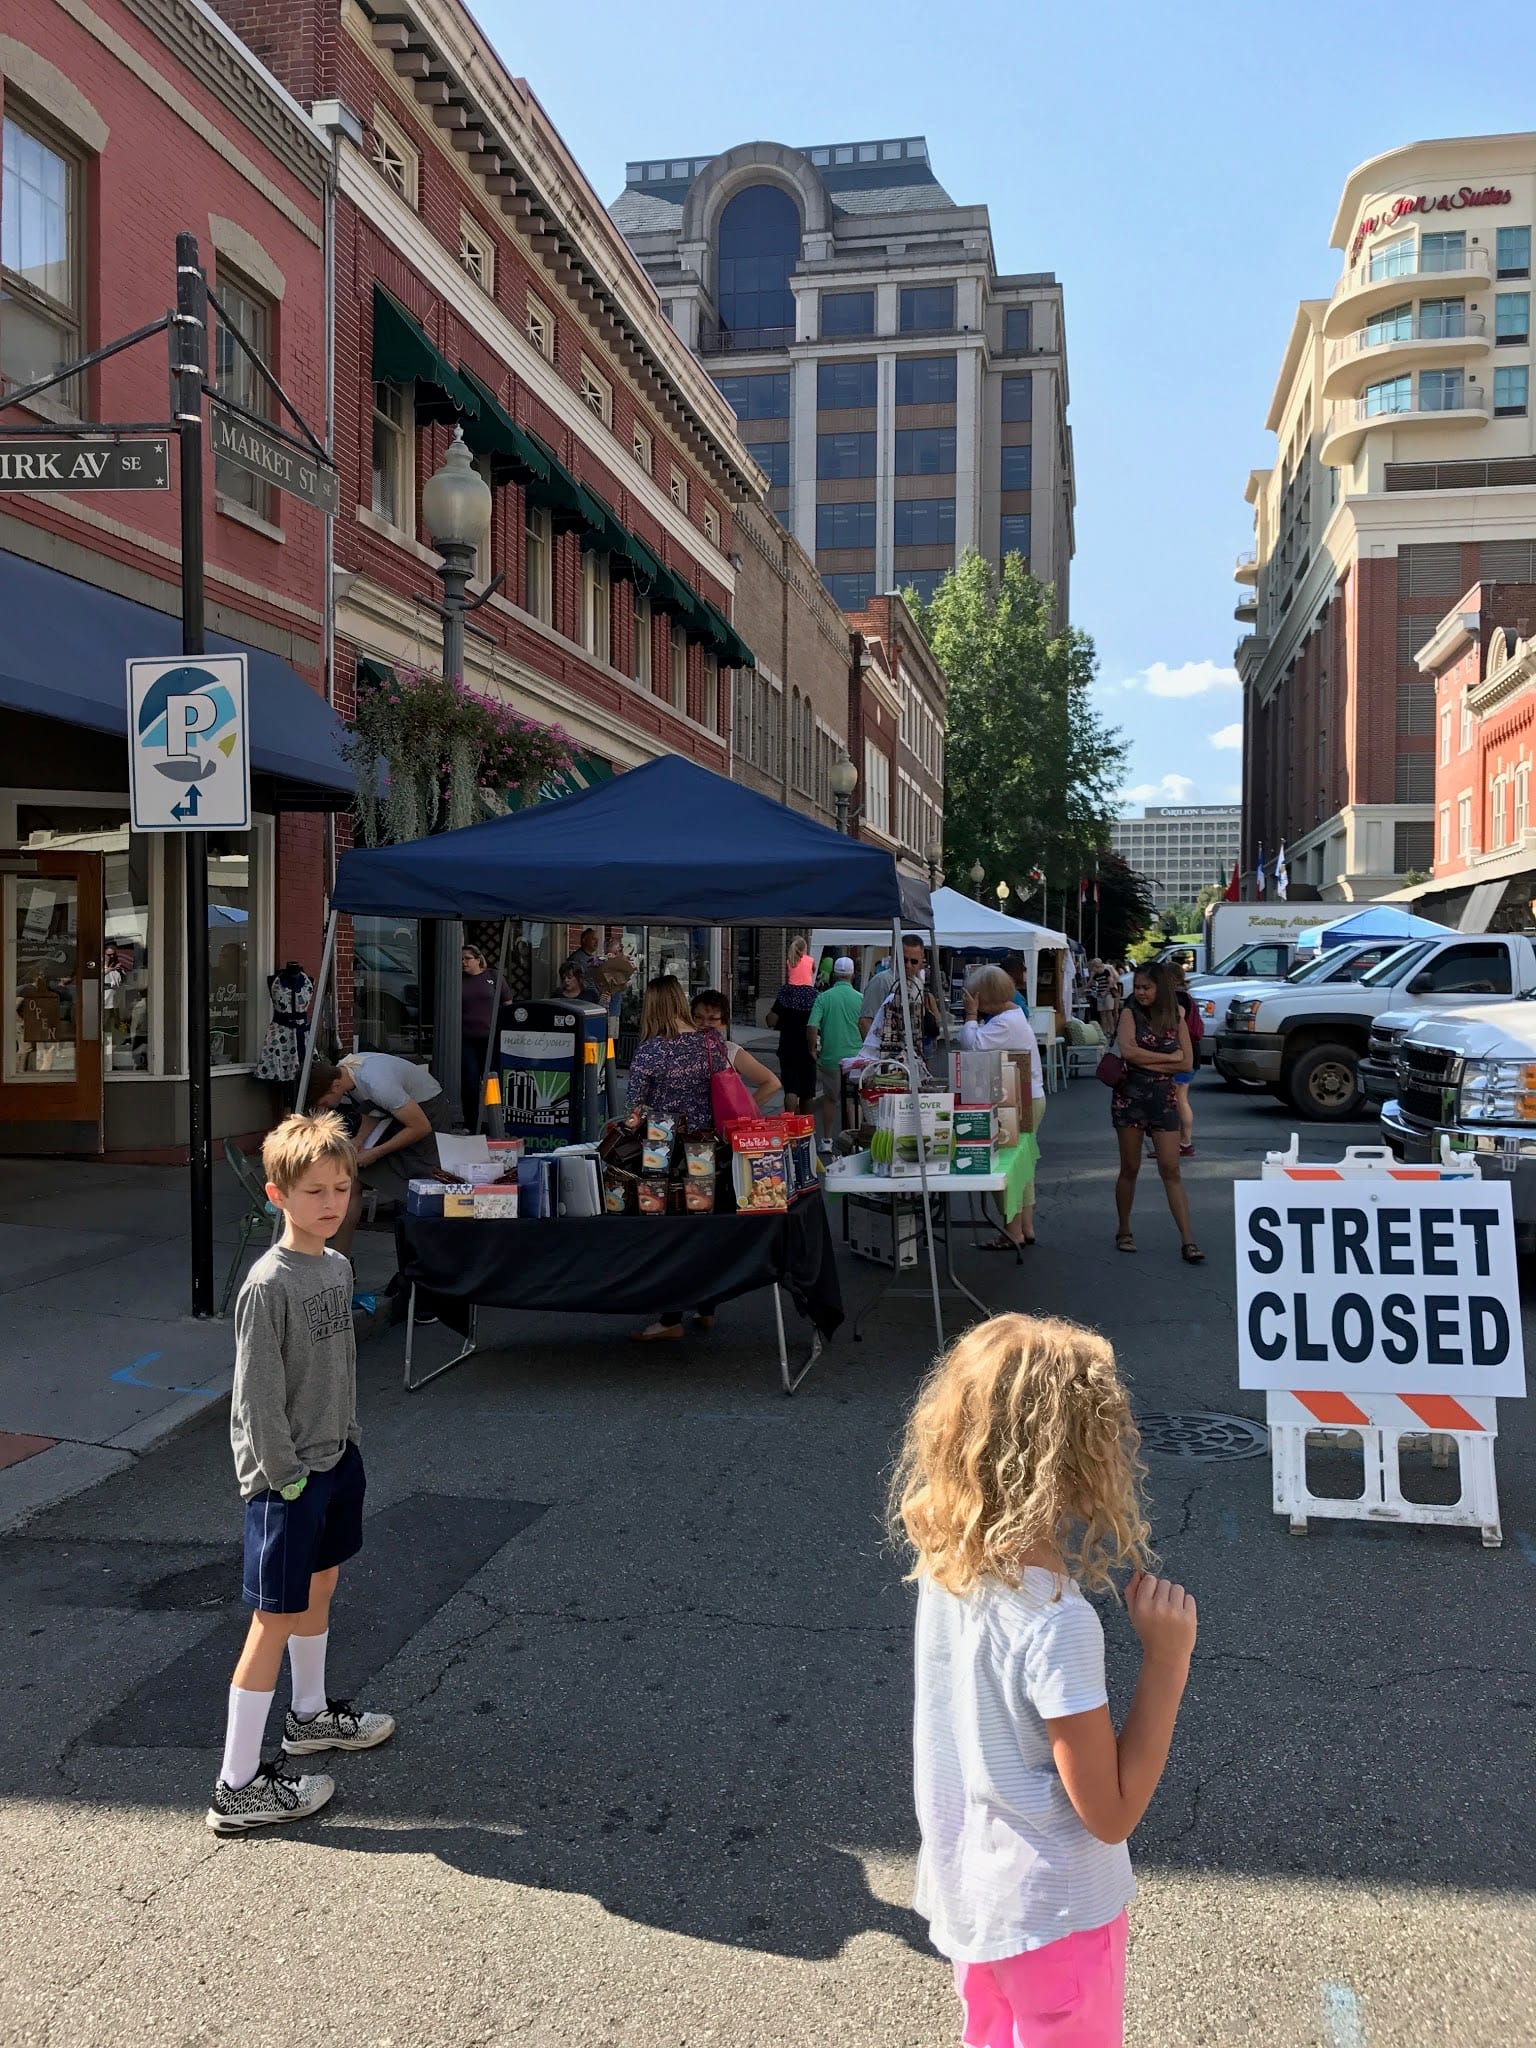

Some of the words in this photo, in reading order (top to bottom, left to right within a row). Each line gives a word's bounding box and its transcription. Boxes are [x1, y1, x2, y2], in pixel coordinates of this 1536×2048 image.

[1451, 186, 1512, 209] Suites
[68, 452, 111, 479] AV
[121, 456, 142, 471] SE
[221, 421, 293, 482] MARKET
[299, 466, 318, 495] ST
[323, 483, 332, 497] SE
[166, 694, 218, 757] P
[29, 1000, 57, 1040] OPEN
[1247, 1206, 1500, 1276] STREET
[1247, 1290, 1511, 1367] CLOSED
